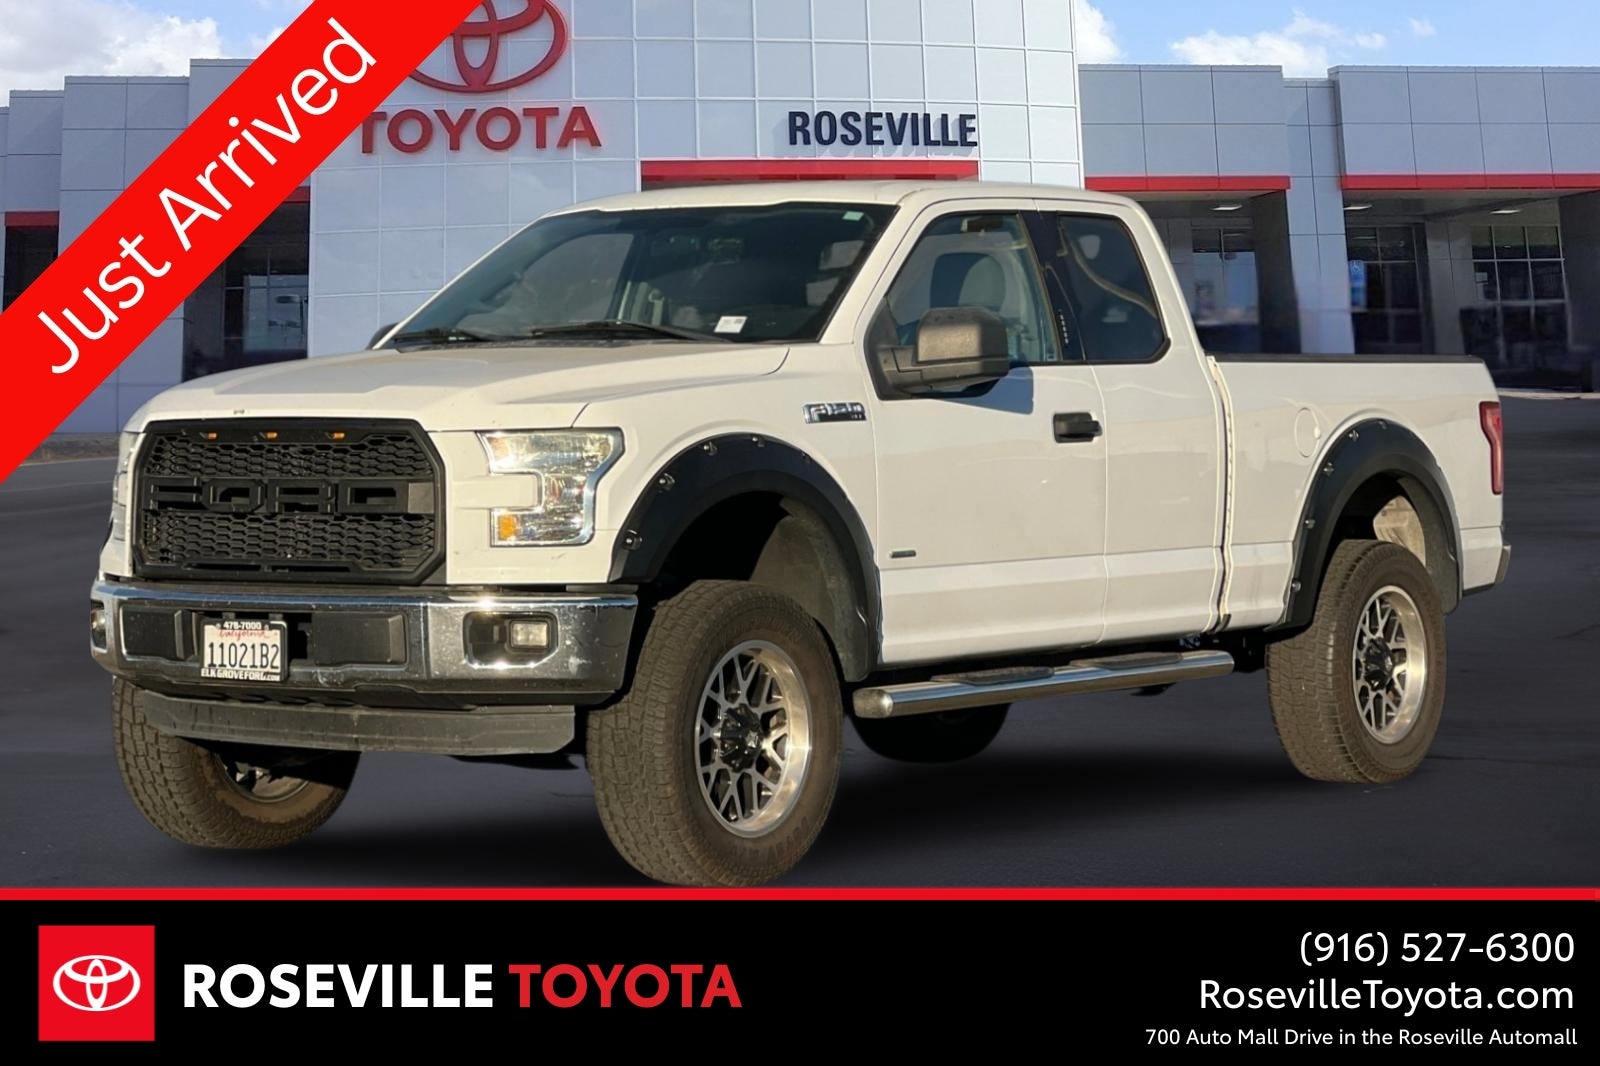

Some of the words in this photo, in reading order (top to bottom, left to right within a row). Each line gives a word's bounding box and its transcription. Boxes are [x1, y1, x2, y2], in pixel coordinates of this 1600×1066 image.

[361, 106, 602, 154] TOYOTA
[788, 110, 978, 147] ROSEVILLE
[208, 642, 279, 669] 11021B2
